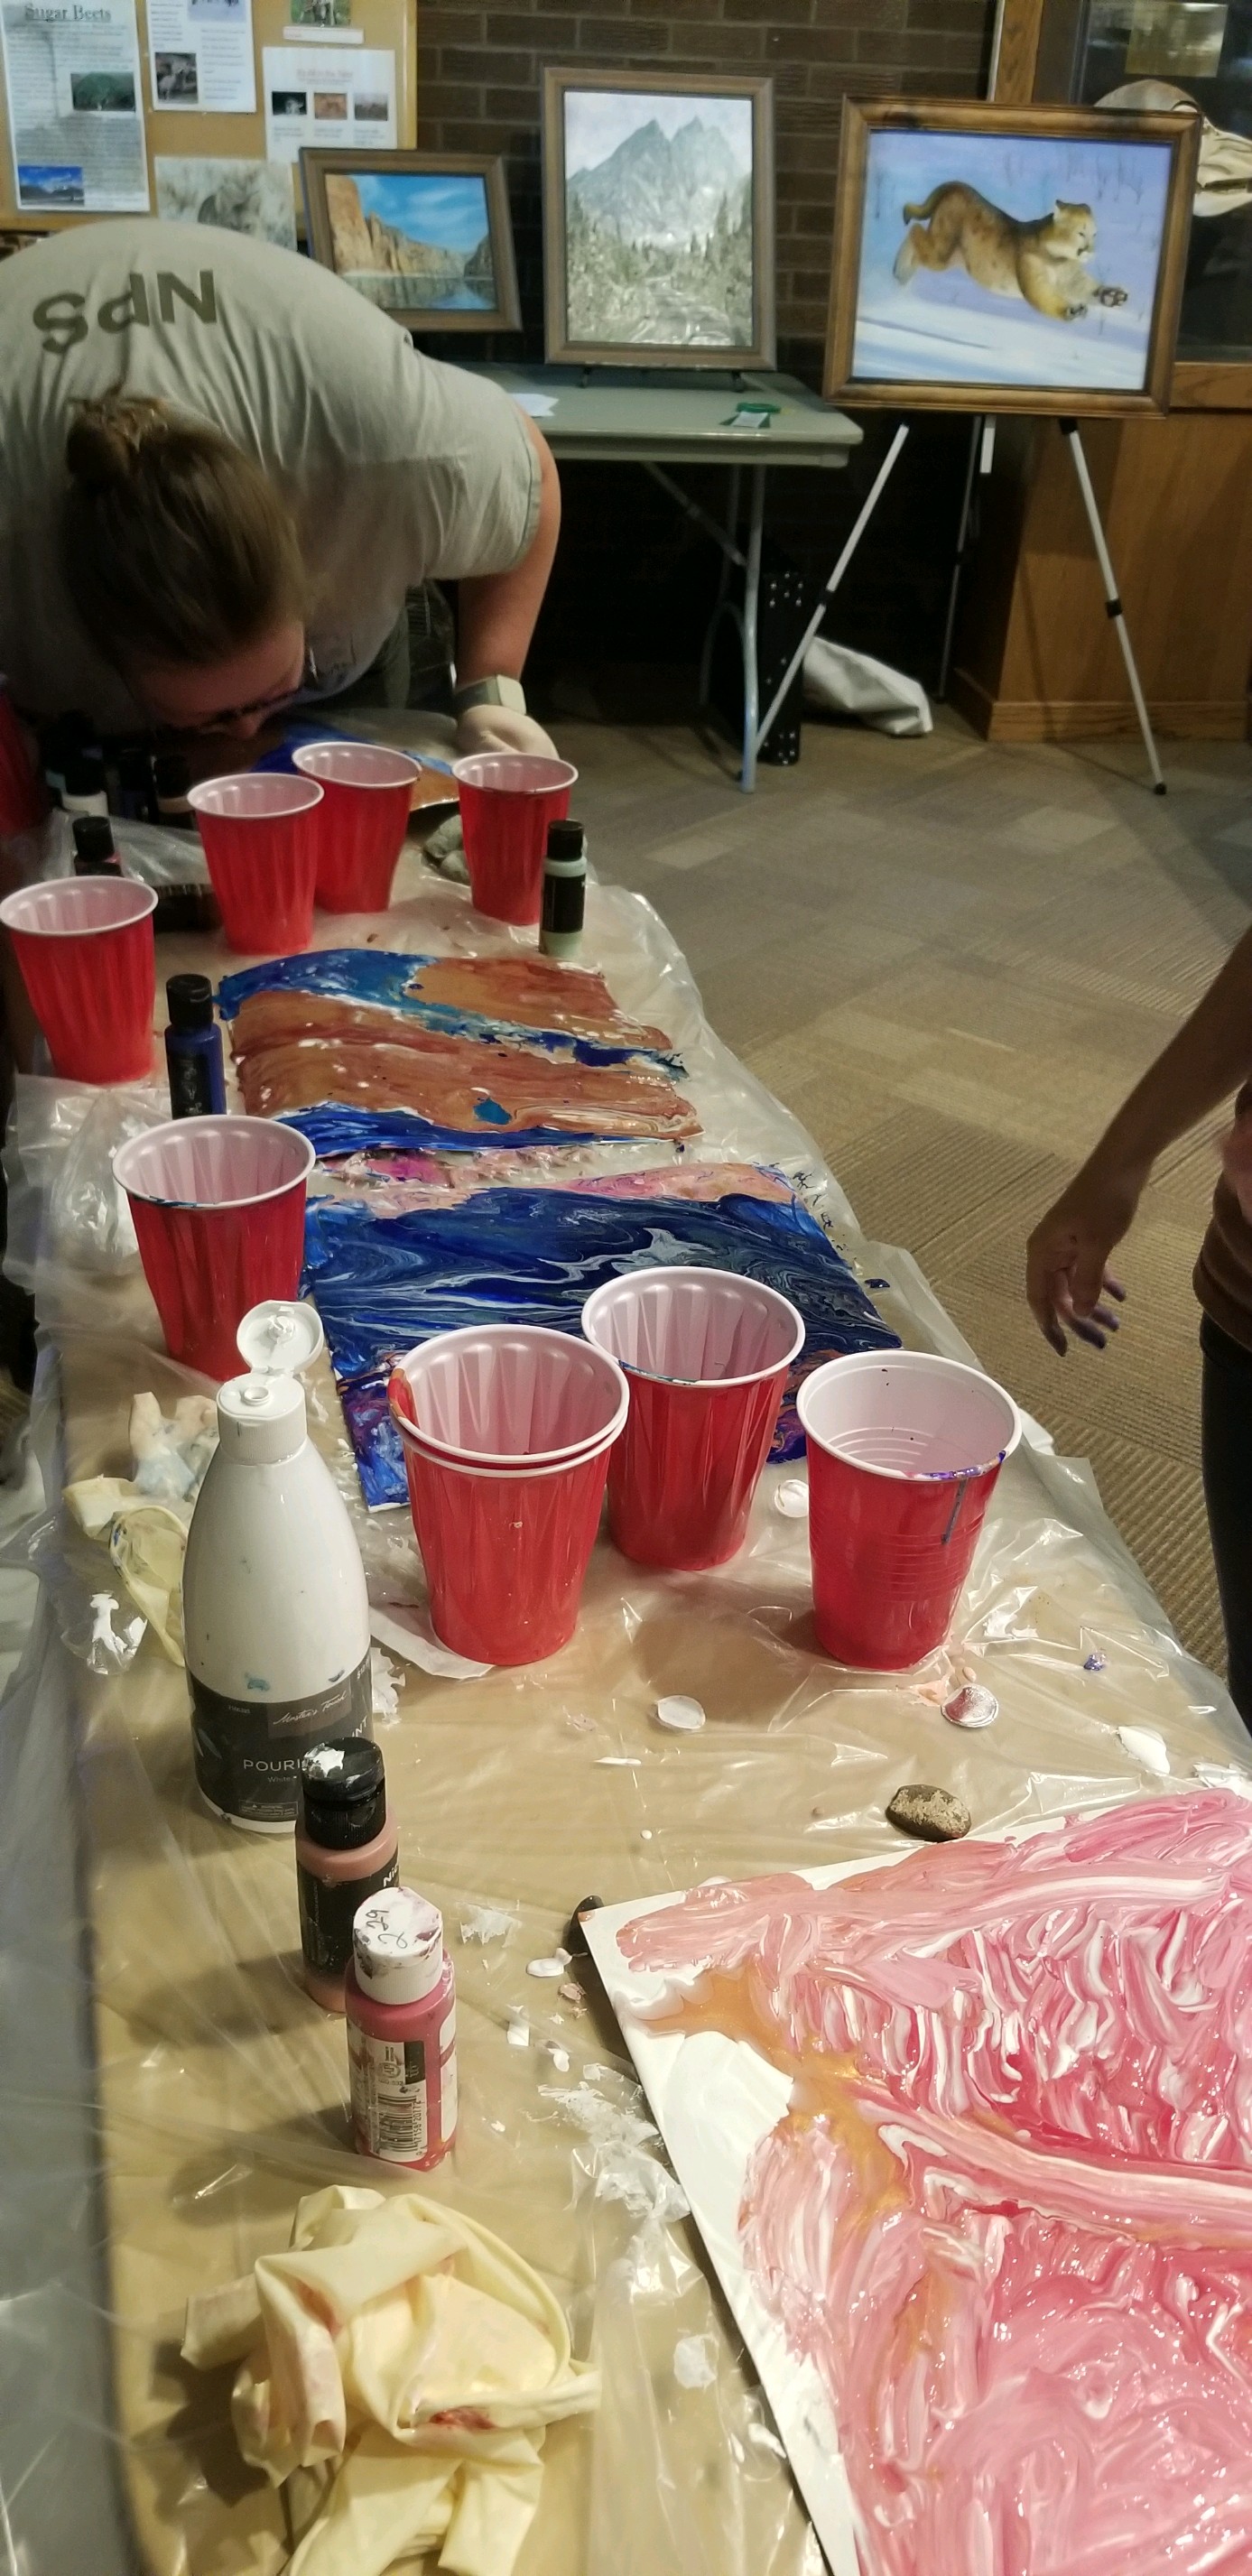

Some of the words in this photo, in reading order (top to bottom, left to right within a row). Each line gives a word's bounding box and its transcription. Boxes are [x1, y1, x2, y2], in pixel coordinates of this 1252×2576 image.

[24, 4, 68, 23] Sugar
[73, 5, 112, 23] Beets
[320, 1690, 348, 1712] Touch
[267, 1775, 292, 1784] White
